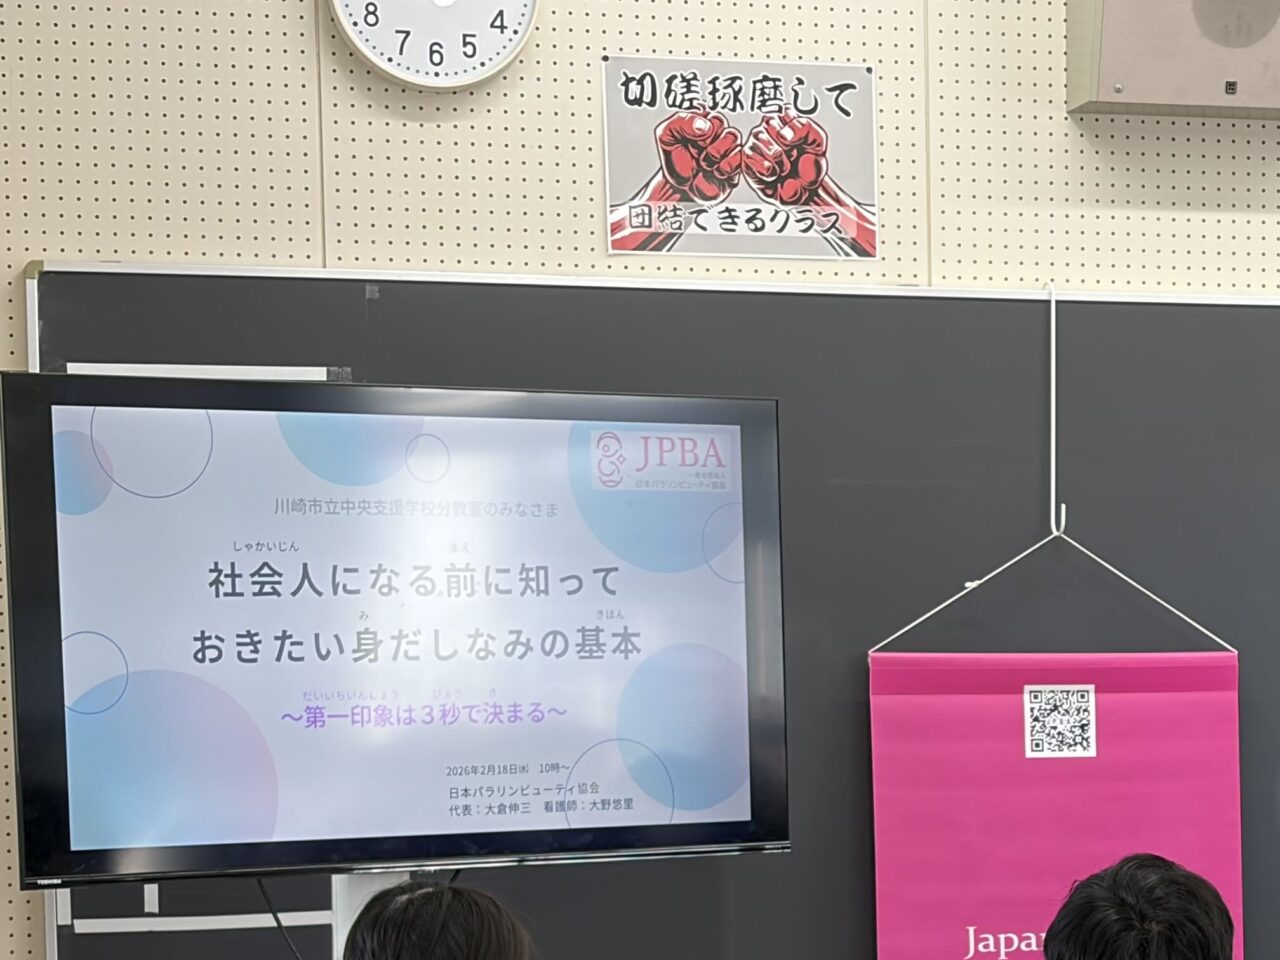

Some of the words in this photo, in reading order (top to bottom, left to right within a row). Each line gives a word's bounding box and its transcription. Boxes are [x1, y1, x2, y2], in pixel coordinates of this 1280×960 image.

[364, 1, 379, 27] 8
[489, 9, 508, 34] 4
[395, 29, 411, 55] 7
[429, 42, 444, 66] 6
[462, 33, 477, 58] 5
[620, 71, 858, 117] 切磋琢磨して
[629, 203, 844, 234] 団結できるクラス
[635, 436, 726, 472] JPBA
[274, 497, 558, 518] 川崎市立中央支援学校分教室のみなさま
[233, 541, 300, 552] しゃかいじん
[208, 561, 620, 599] 社会人になる前に知って
[193, 626, 642, 663] おきたい身だしなみの基本
[449, 782, 600, 800] 日本パラリンビューティ協会
